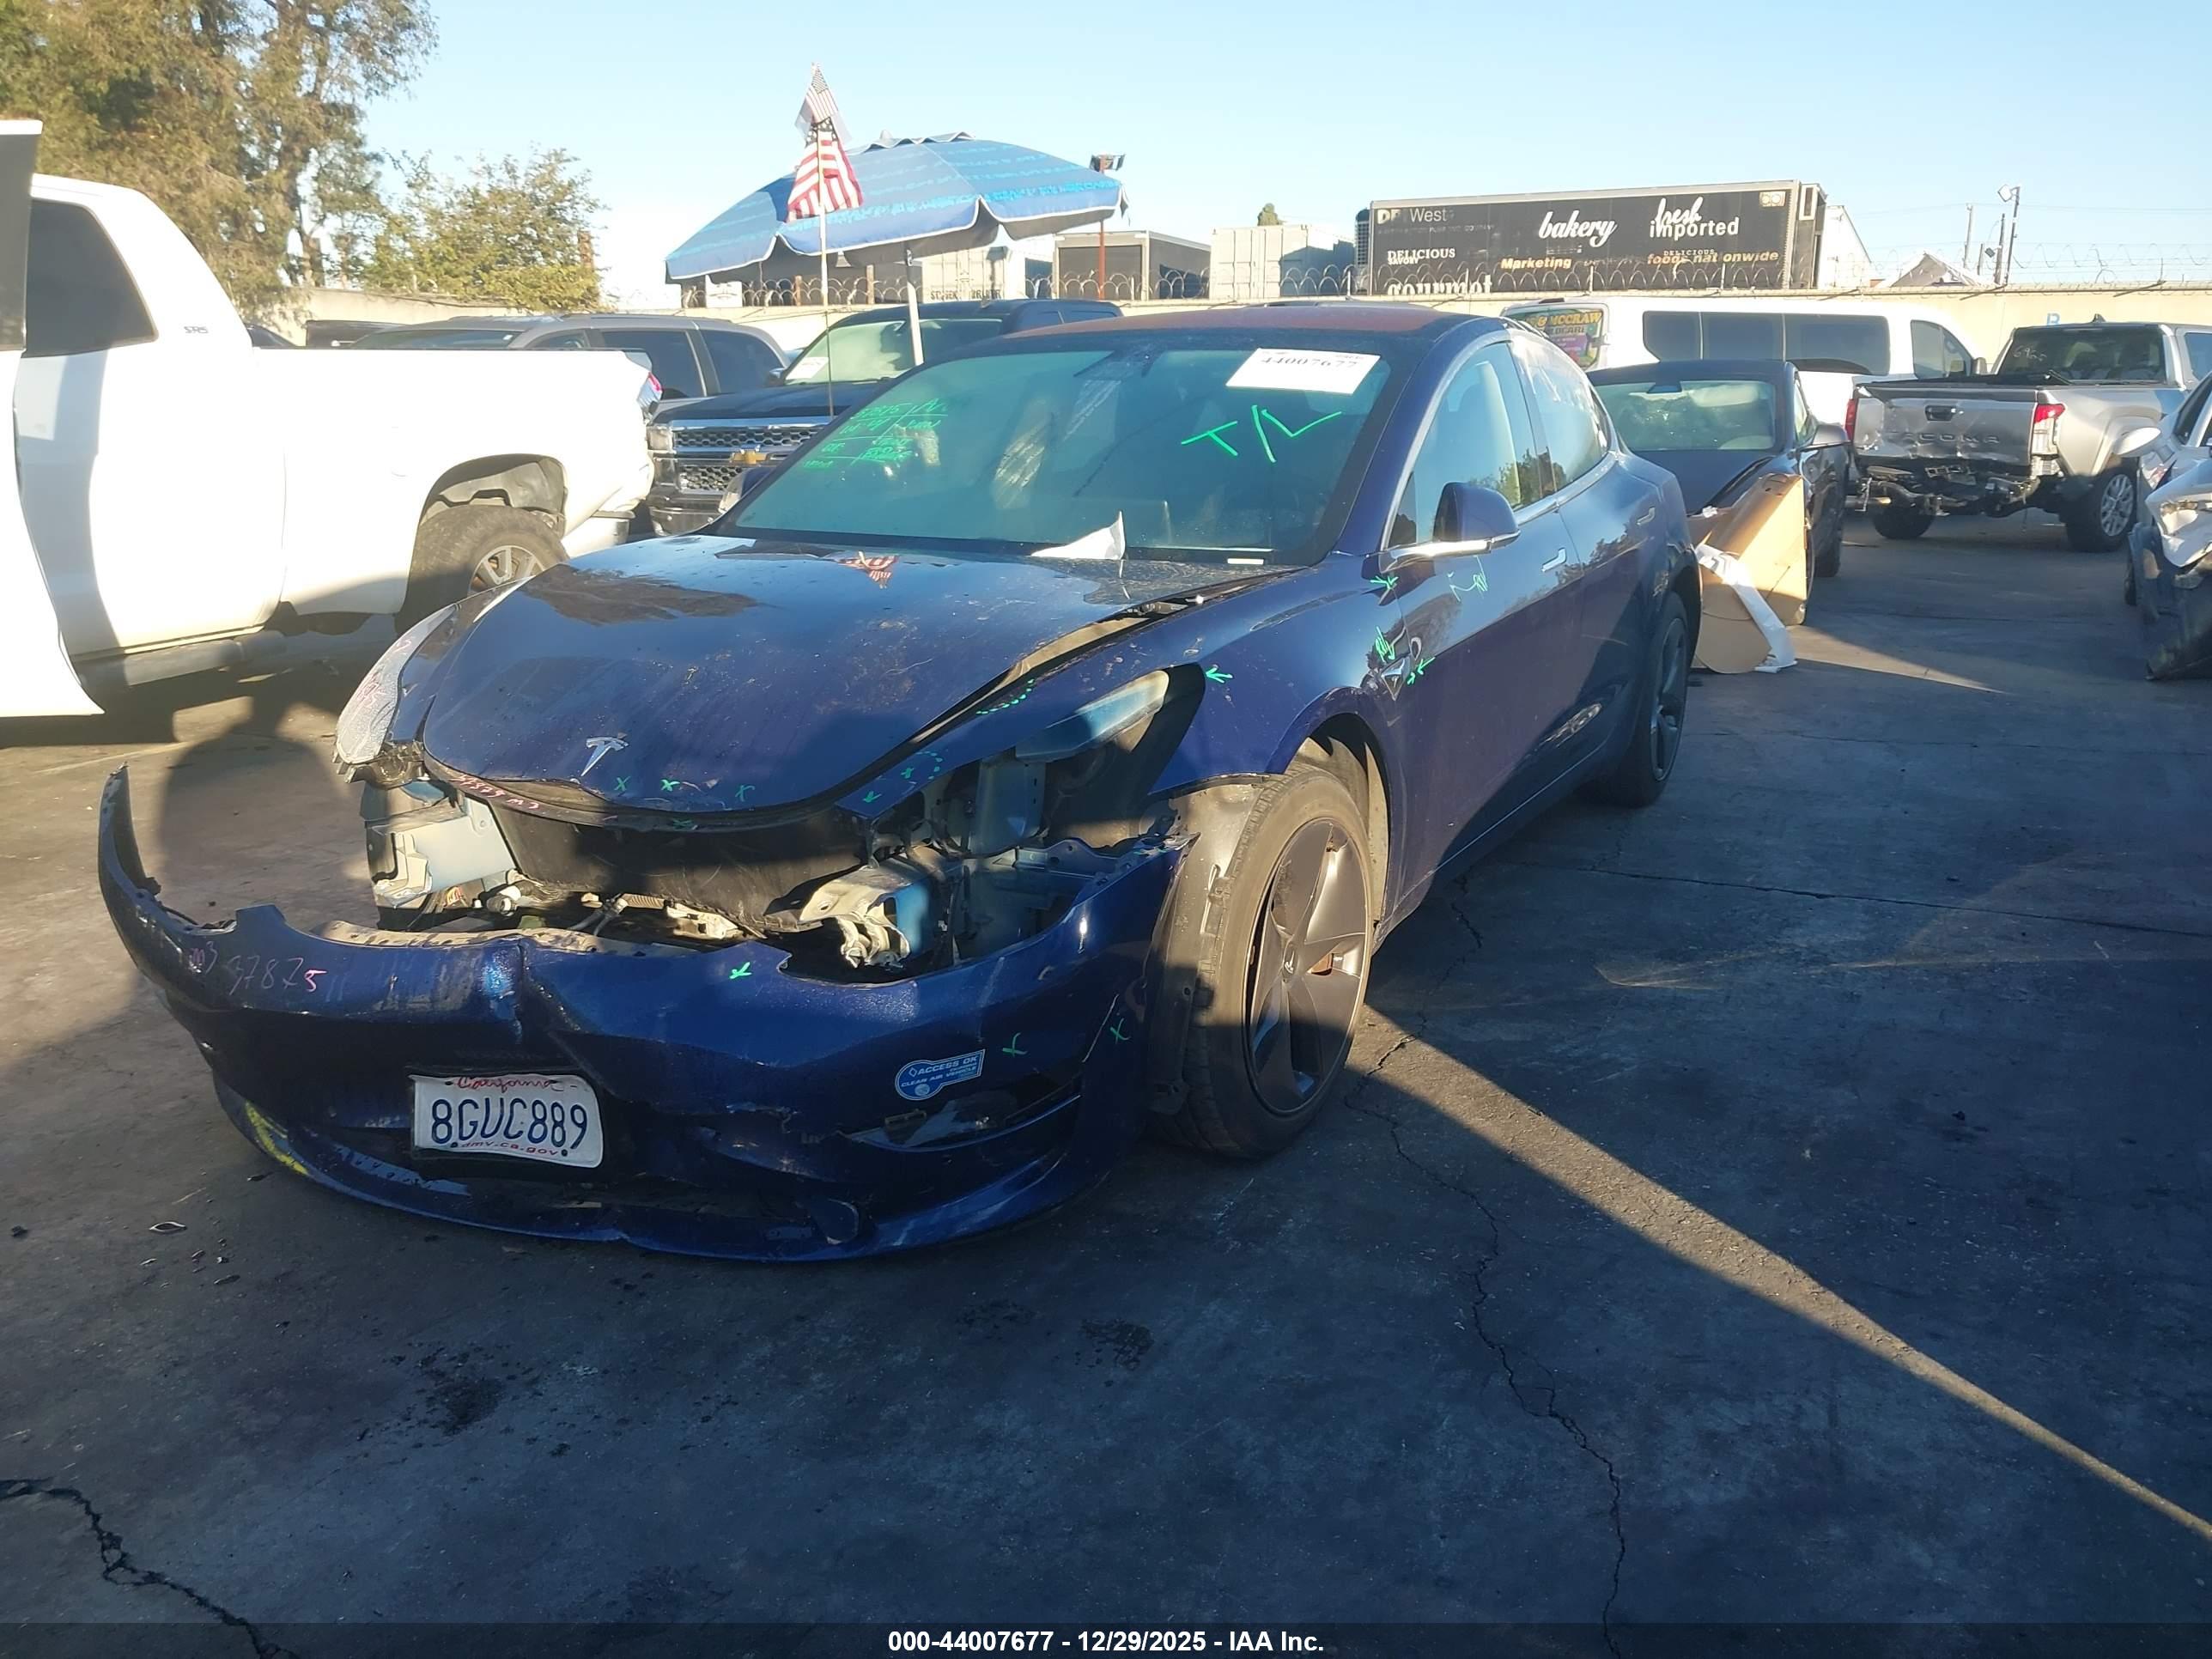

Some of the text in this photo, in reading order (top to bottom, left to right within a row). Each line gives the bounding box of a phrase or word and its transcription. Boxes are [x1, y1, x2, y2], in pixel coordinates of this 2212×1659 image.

[1410, 208, 1448, 223] West
[1539, 210, 1618, 247] bakery
[1650, 216, 1740, 240] imported
[1388, 248, 1455, 260] DELICIOUS
[1388, 257, 1419, 265] SAVORY
[1693, 251, 1779, 264] natonwide
[1500, 257, 1572, 270] Marketing
[917, 1060, 959, 1075] ACCESS
[963, 1055, 979, 1065] OK
[901, 1078, 928, 1087] CLEAN
[431, 1097, 588, 1150] 8GUC889
[461, 1141, 559, 1156] dmv.ca.gov
